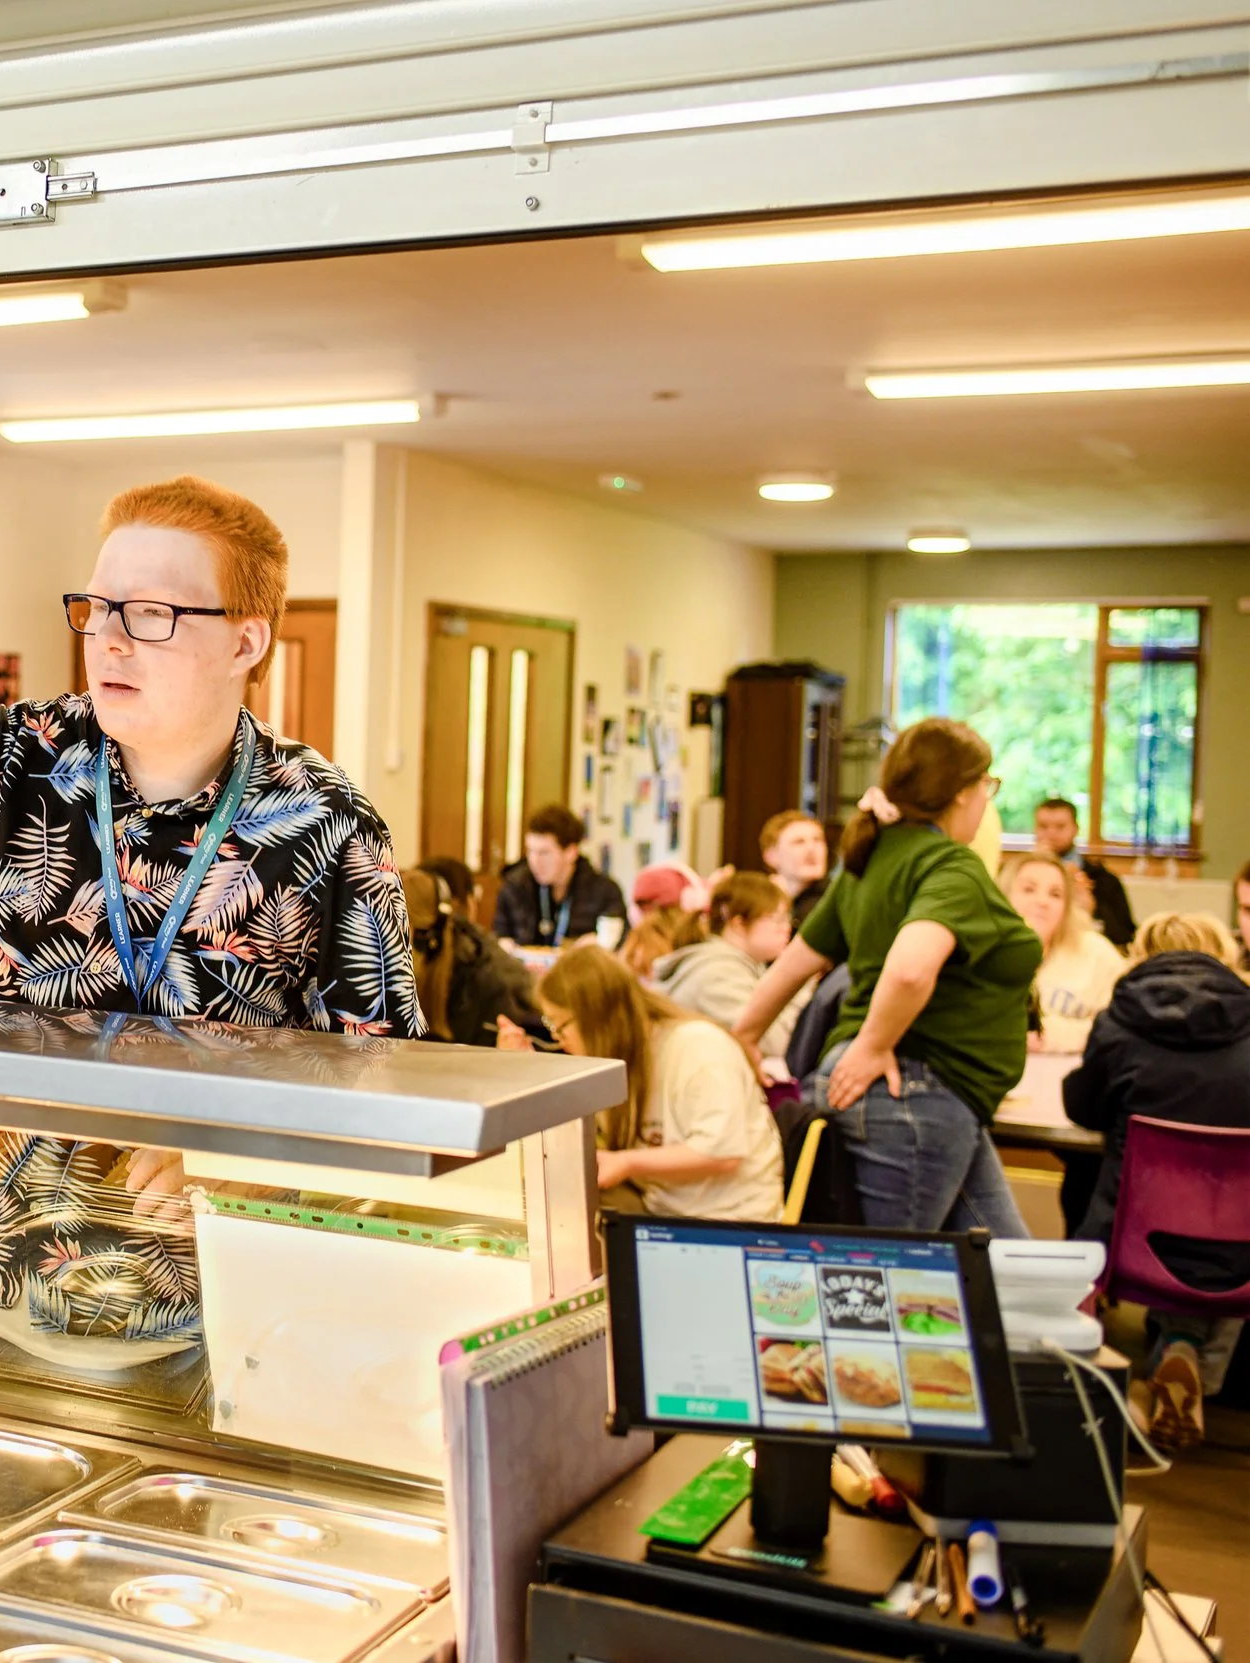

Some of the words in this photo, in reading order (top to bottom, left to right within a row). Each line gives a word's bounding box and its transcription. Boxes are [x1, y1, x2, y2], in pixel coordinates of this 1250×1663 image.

[218, 793, 234, 823] LEARNER
[178, 875, 196, 905] LEARNER
[115, 912, 126, 944] LEARNER
